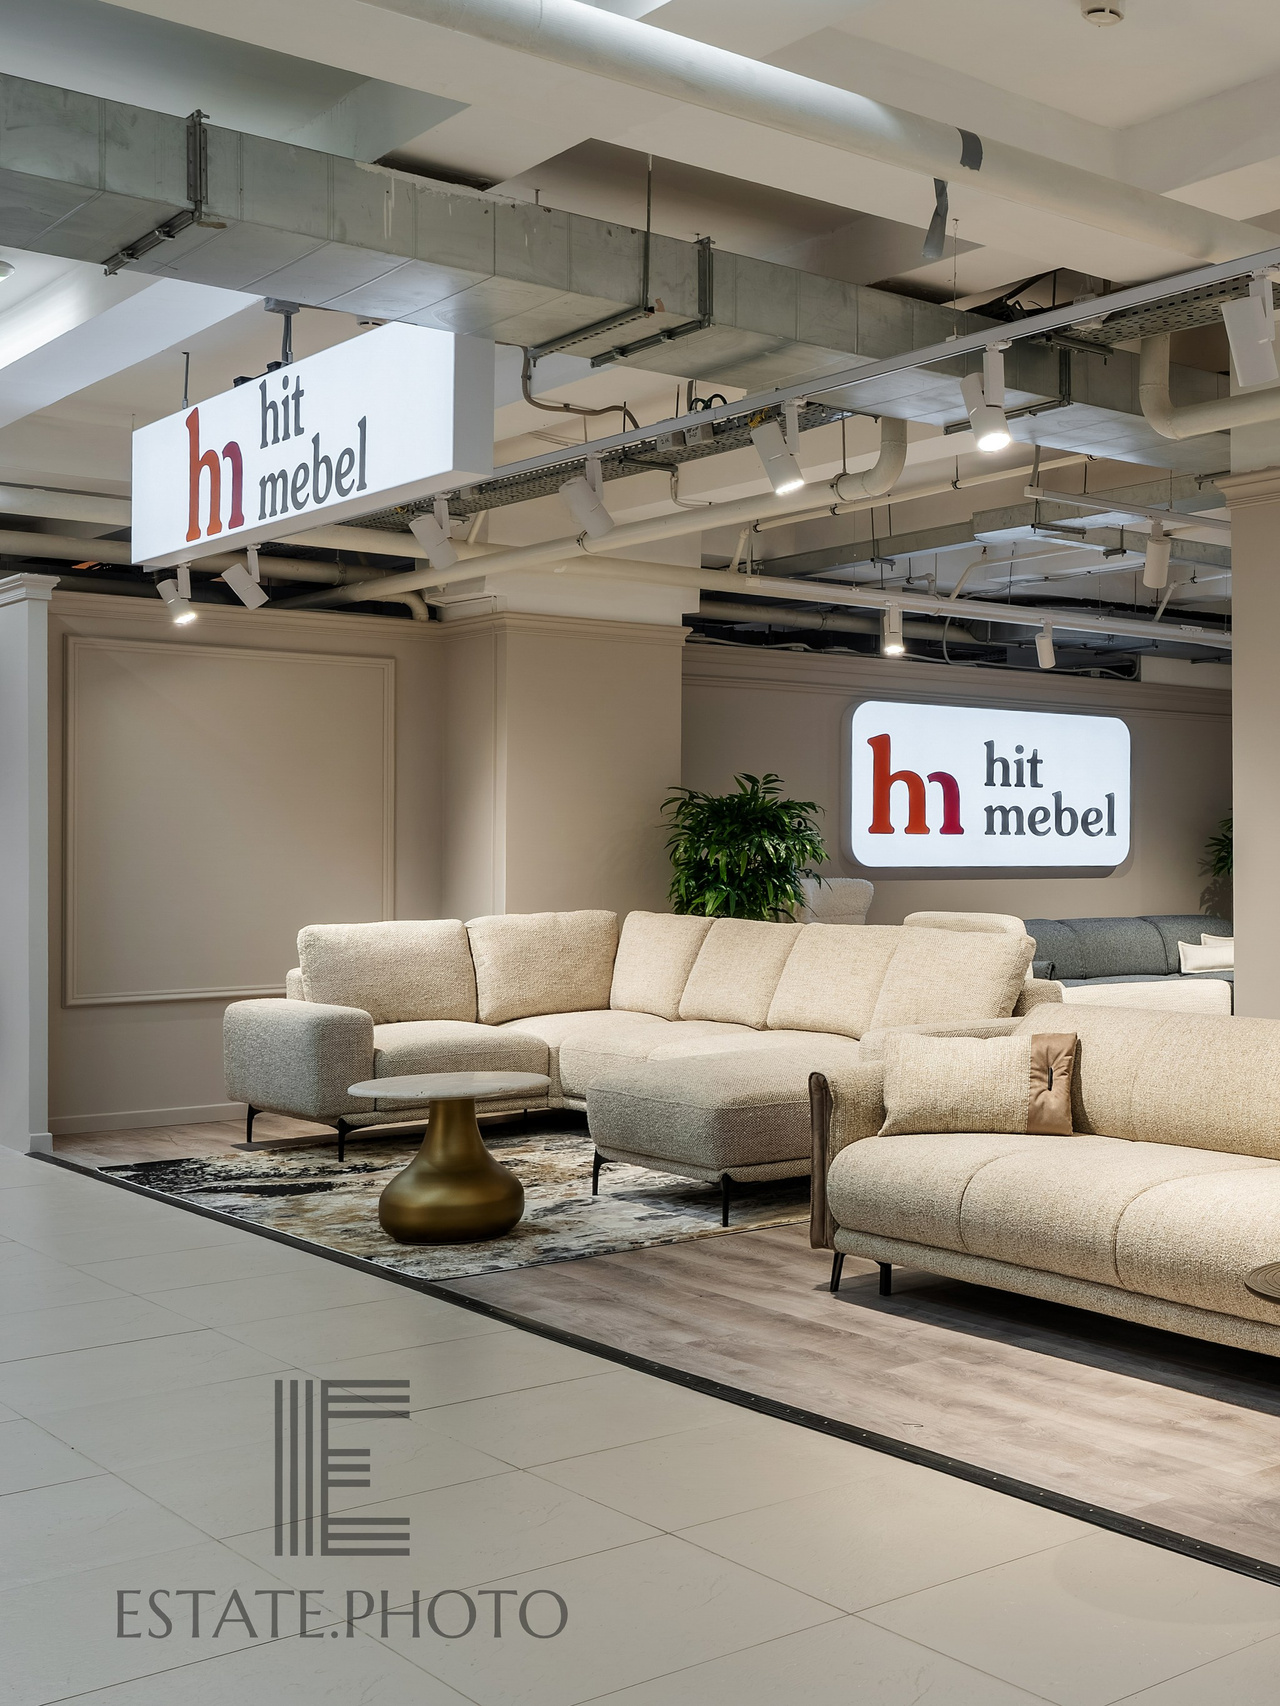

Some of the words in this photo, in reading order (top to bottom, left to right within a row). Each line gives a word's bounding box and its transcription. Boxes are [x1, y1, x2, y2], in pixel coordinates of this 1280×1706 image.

[258, 374, 305, 450] hit
[258, 415, 368, 521] mebel
[983, 739, 1044, 788] hit
[983, 790, 1117, 837] mebel
